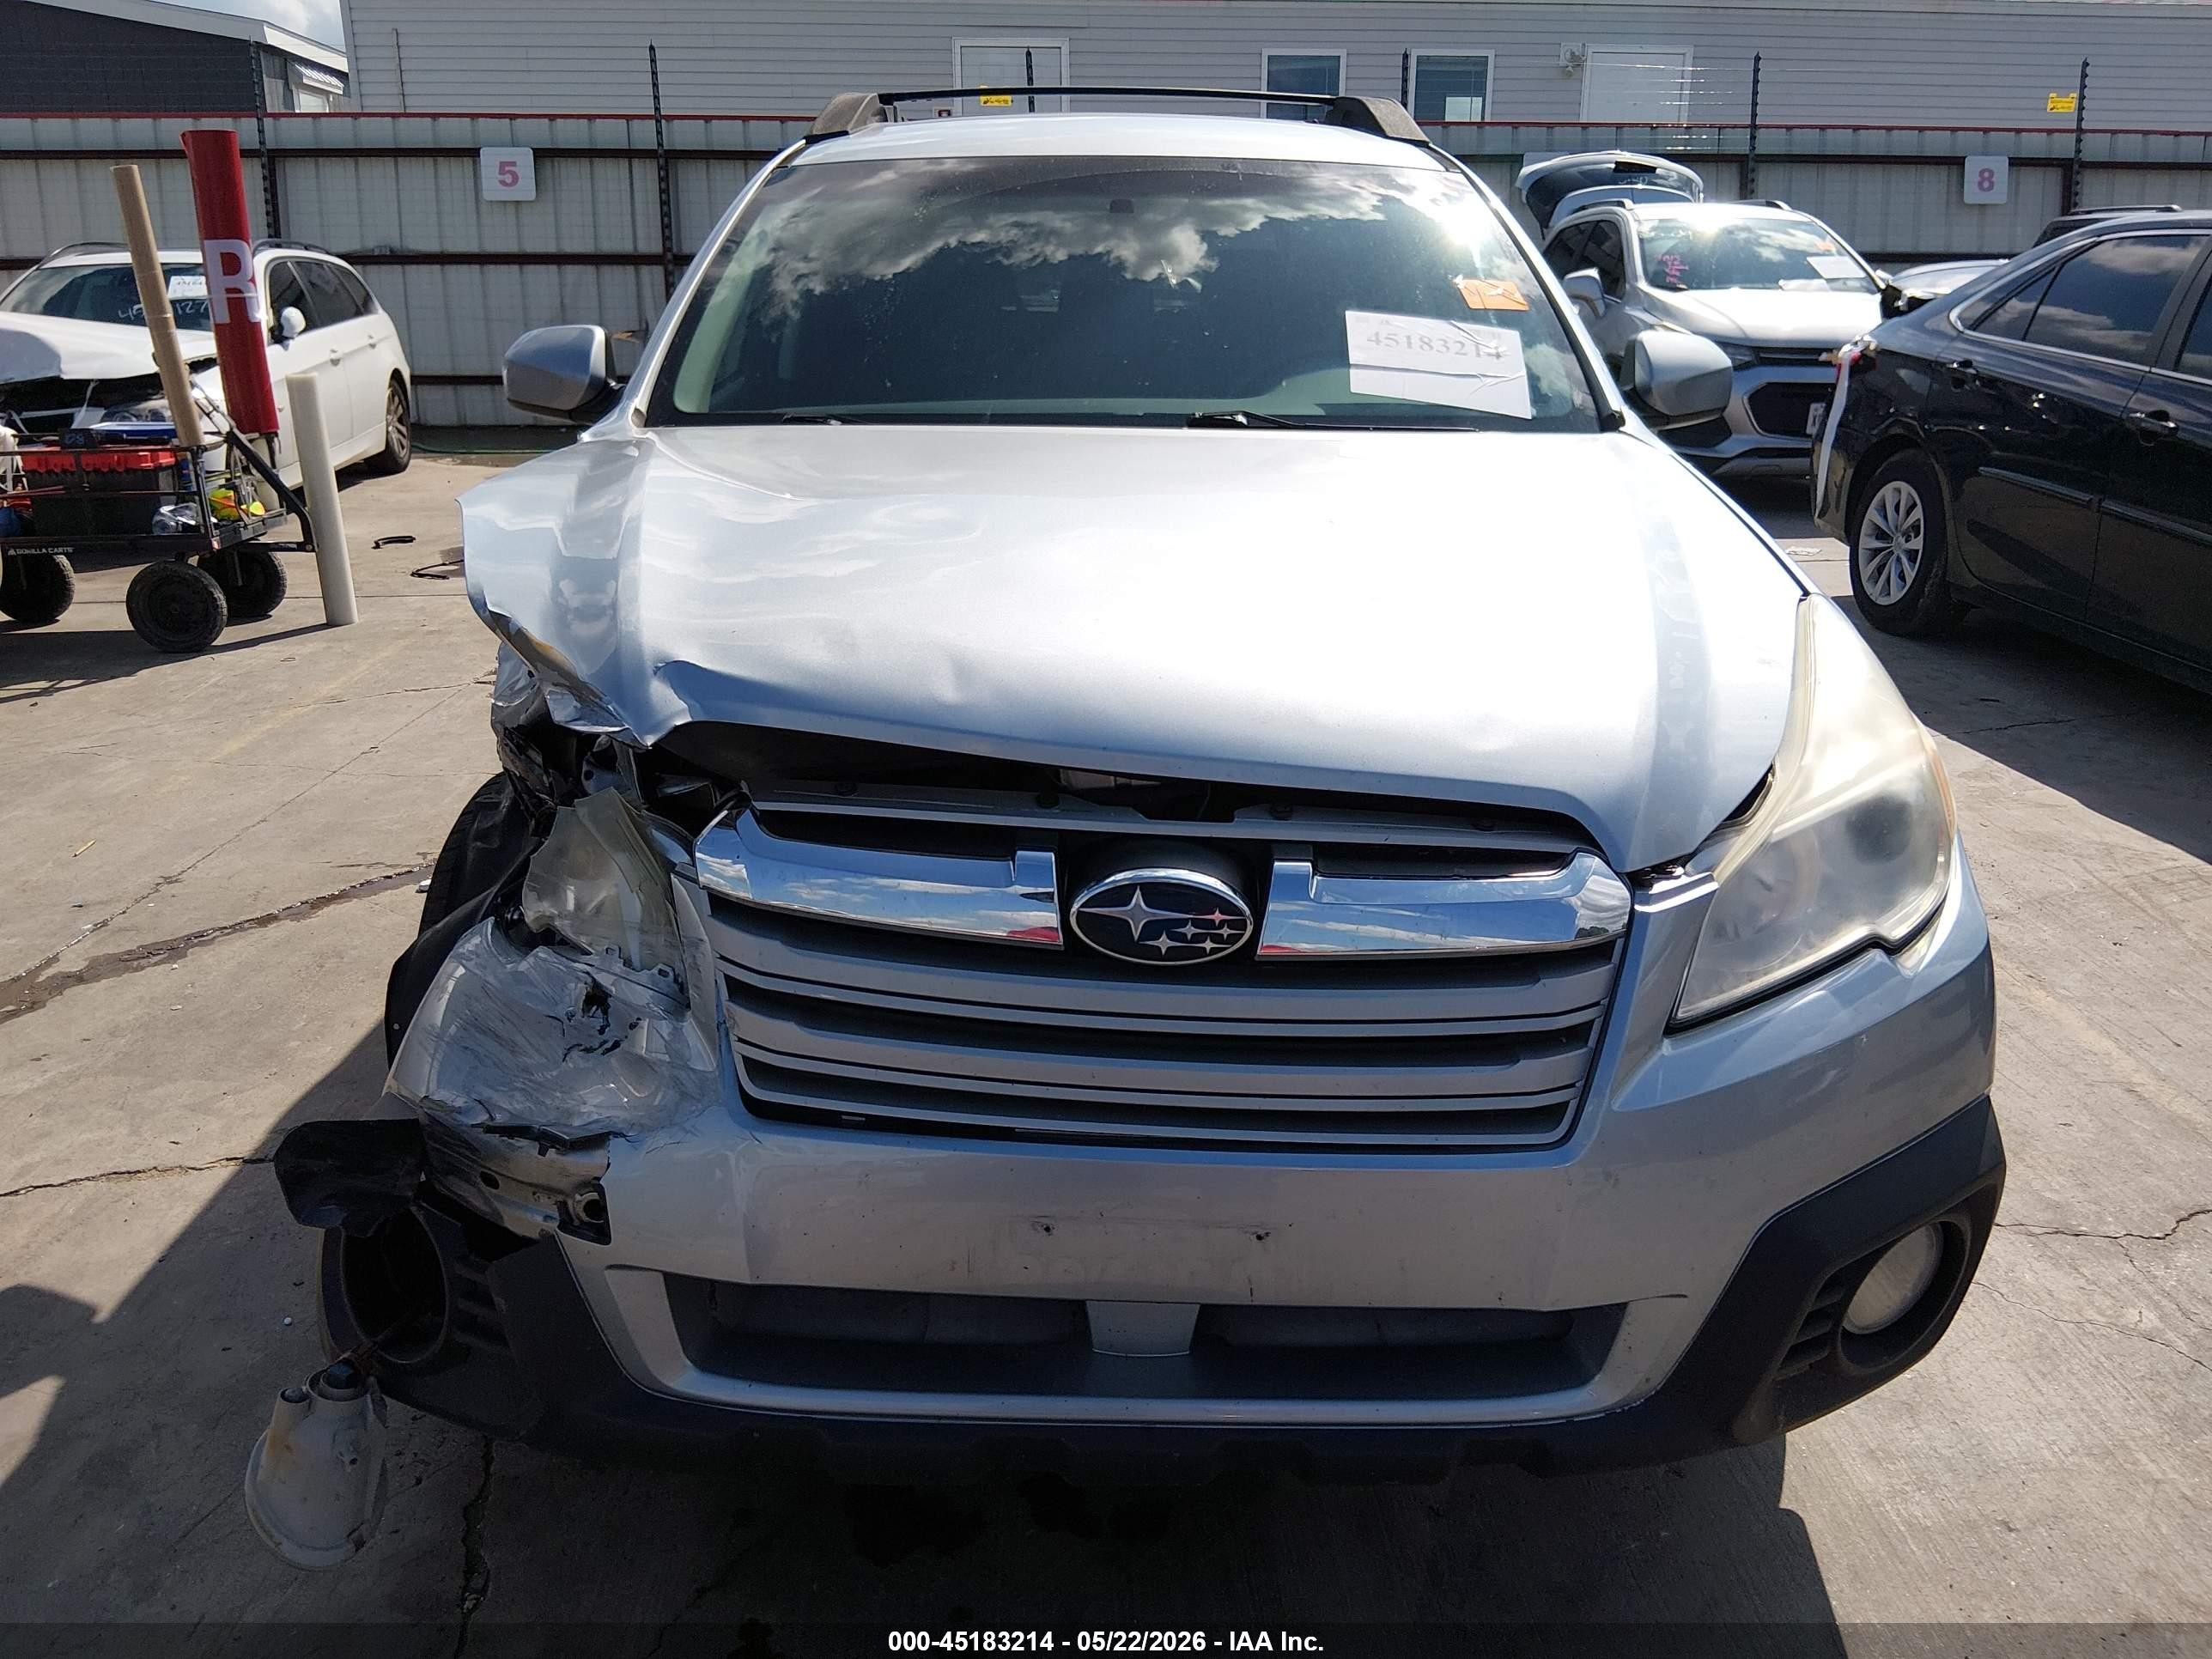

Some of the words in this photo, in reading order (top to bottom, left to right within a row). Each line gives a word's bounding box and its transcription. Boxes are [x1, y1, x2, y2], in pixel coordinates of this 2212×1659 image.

[497, 161, 520, 187] 5
[1977, 167, 1995, 192] 8
[204, 239, 261, 325] R
[1367, 331, 1509, 360] 45183214
